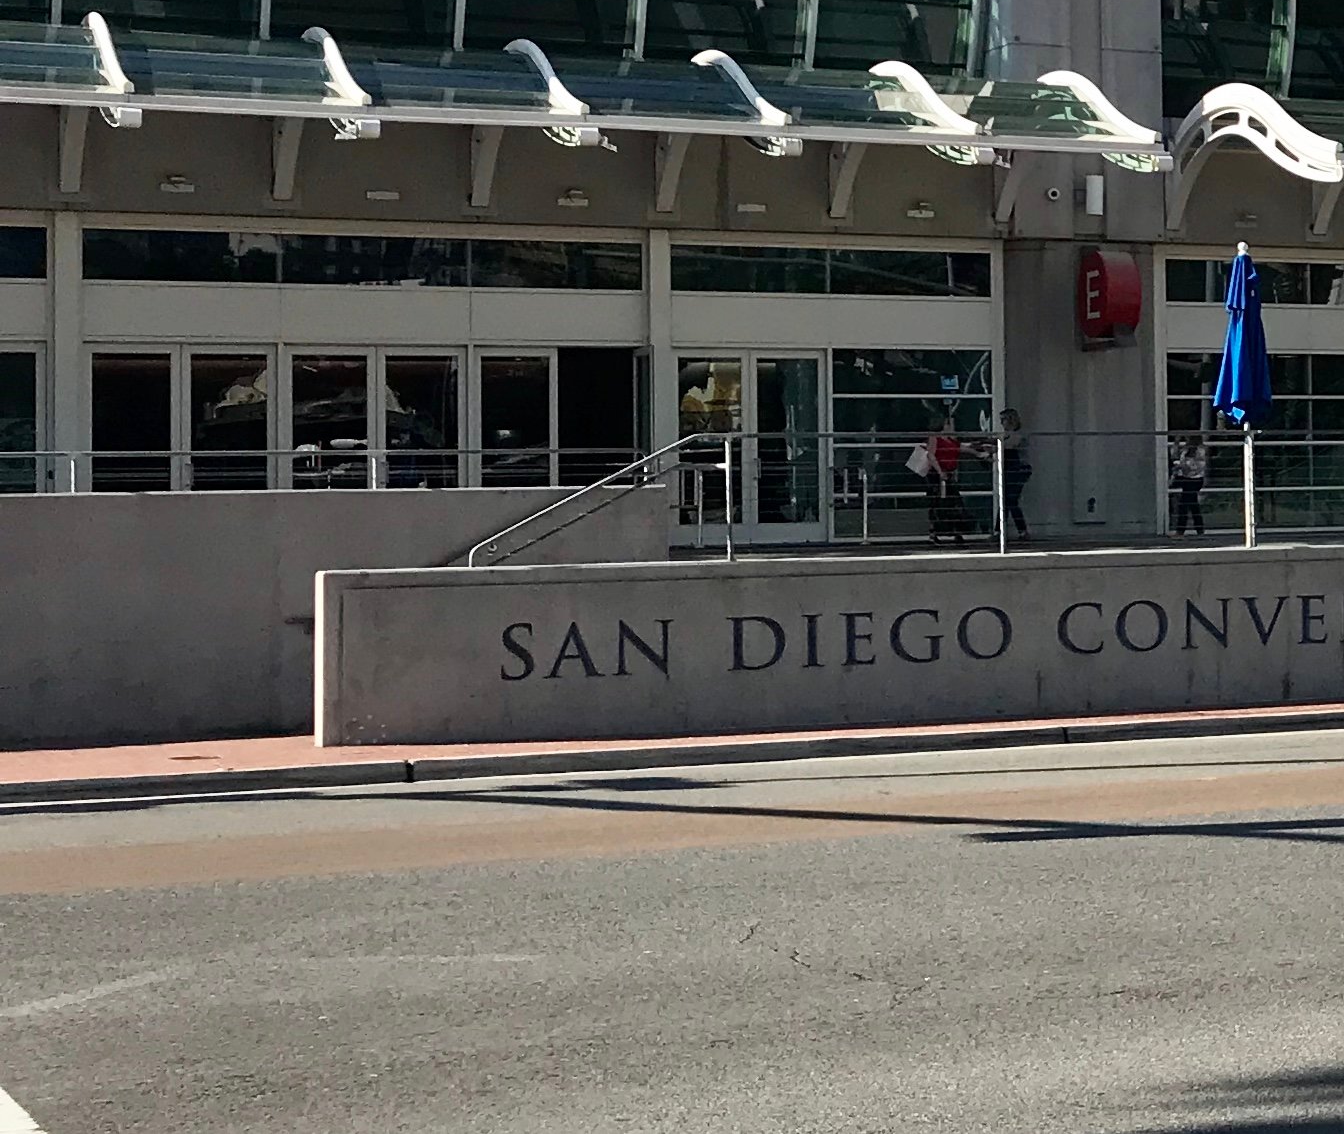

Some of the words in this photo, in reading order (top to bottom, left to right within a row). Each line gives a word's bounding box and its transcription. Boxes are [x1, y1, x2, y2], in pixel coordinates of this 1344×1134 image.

[1086, 270, 1100, 319] E
[500, 618, 675, 682] SAN
[726, 606, 1013, 672] DIEGO
